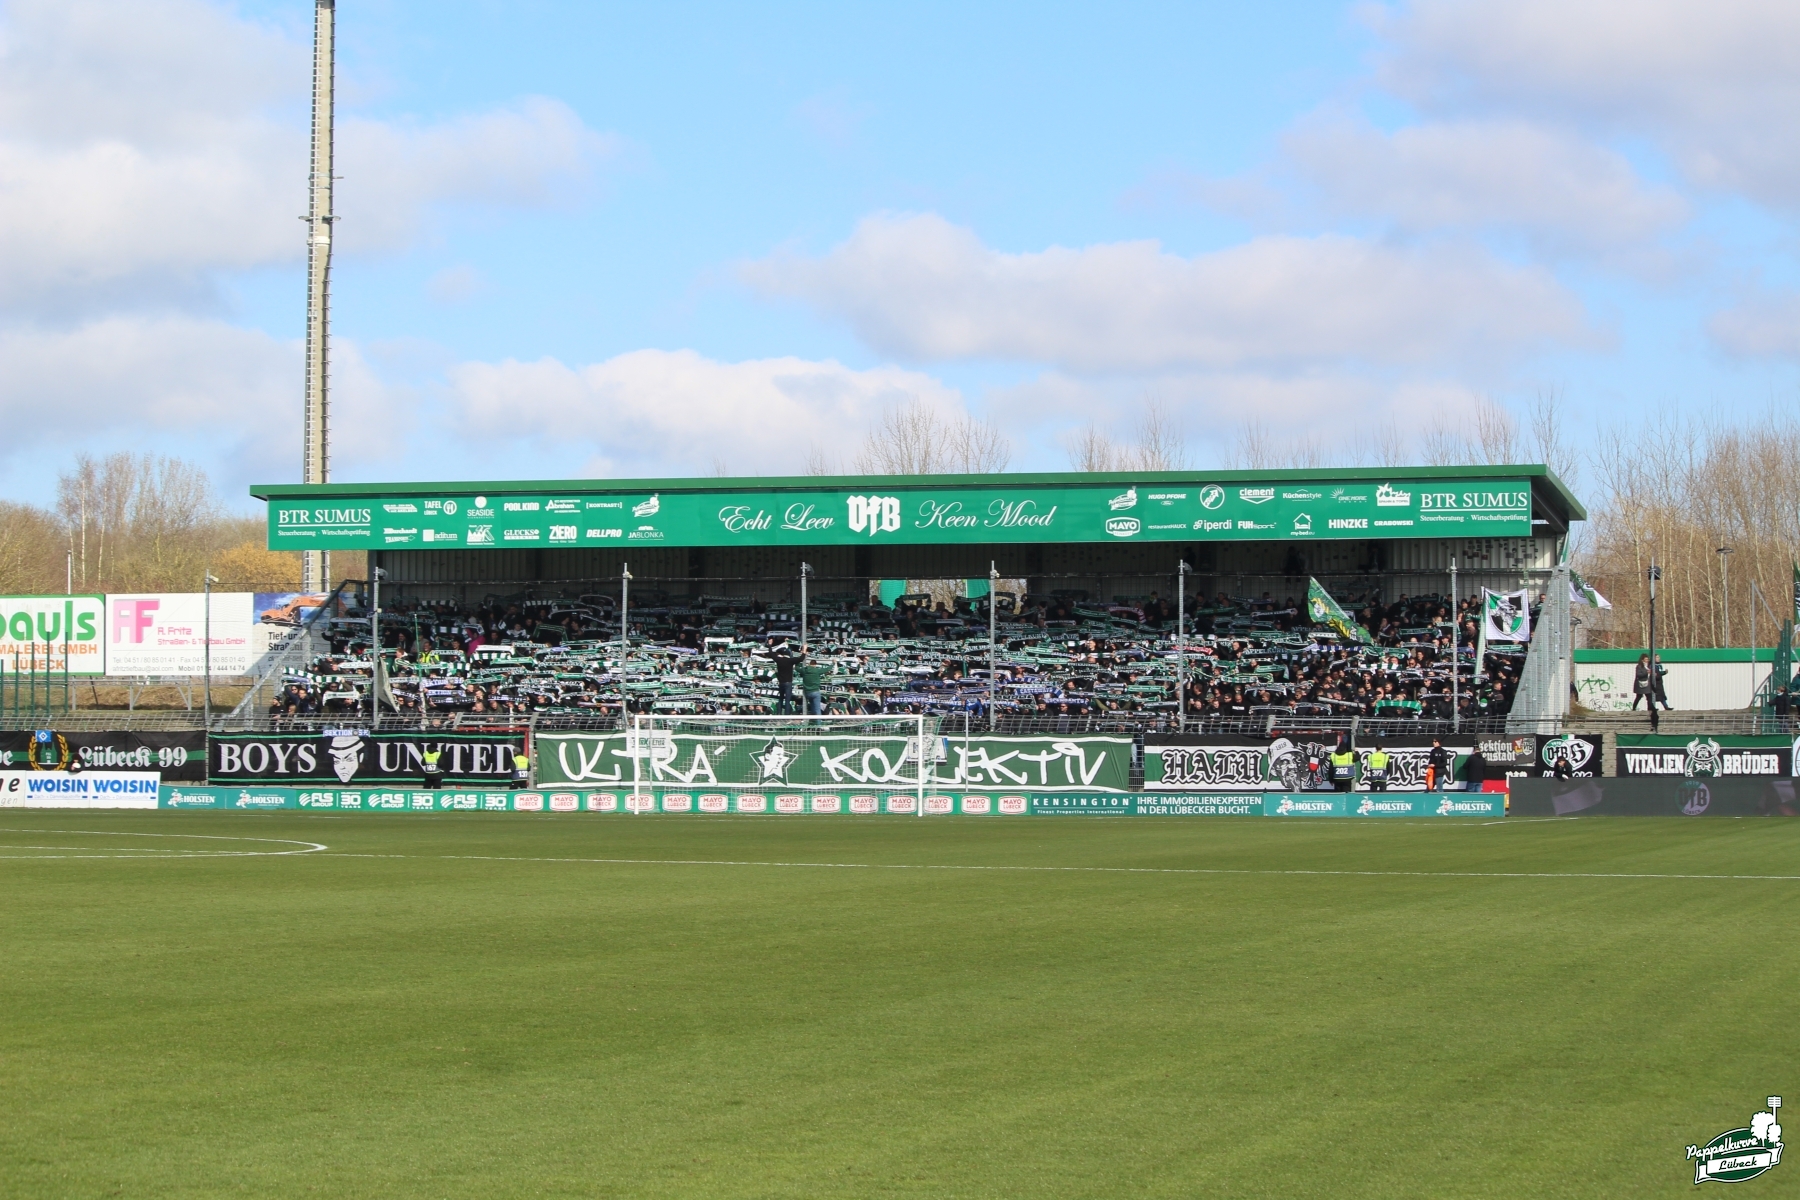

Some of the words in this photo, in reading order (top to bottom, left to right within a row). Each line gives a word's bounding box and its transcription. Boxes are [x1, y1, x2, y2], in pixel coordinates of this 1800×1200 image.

[1240, 488, 1275, 496] clement
[1420, 493, 1458, 508] BTR
[1462, 492, 1528, 508] SUMUS
[545, 500, 574, 511] Abraham
[278, 510, 310, 524] BTR
[314, 509, 371, 523] SUMUS
[718, 506, 773, 533] Echt
[780, 502, 835, 531] Leev
[846, 495, 901, 537] VfB
[915, 500, 979, 529] Keen
[983, 499, 1058, 527] Mood
[1470, 514, 1528, 522] Wirtschaftsprüfung
[1109, 522, 1137, 530] MAYO
[1204, 520, 1232, 532] iperdi
[1328, 519, 1368, 529] HINZKE
[321, 528, 371, 537] Wirtschaftsprüfung
[586, 529, 622, 538] DELLPRO
[168, 627, 192, 635] Fritz
[58, 644, 98, 654] GMBH
[12, 657, 65, 670] LÜBECK
[78, 745, 152, 768] Lübeck
[158, 746, 188, 767] 99
[218, 742, 317, 773] BOYS
[376, 742, 516, 774] UNTED
[1481, 750, 1516, 762] eustadt
[1625, 754, 1684, 774] VITALIEN
[1722, 752, 1780, 774] BRÜDER
[1336, 767, 1348, 775] 202
[28, 778, 88, 793] WOISIN
[93, 780, 157, 794] WOISIN
[311, 793, 334, 803] FLS
[341, 794, 361, 804] 30
[382, 794, 404, 804] FLS
[412, 796, 434, 806] 30
[454, 794, 478, 804] FLS
[486, 796, 506, 807] 30
[1034, 798, 1129, 806] KENSINGTON
[1160, 796, 1262, 804] IMMOBILIENEXPERTEN
[1137, 806, 1146, 814] IN
[1150, 806, 1168, 814] DER
[1171, 804, 1216, 814] LÜBECKER
[1218, 806, 1251, 814] BUCHT.
[1455, 803, 1492, 811] HOLSTEN
